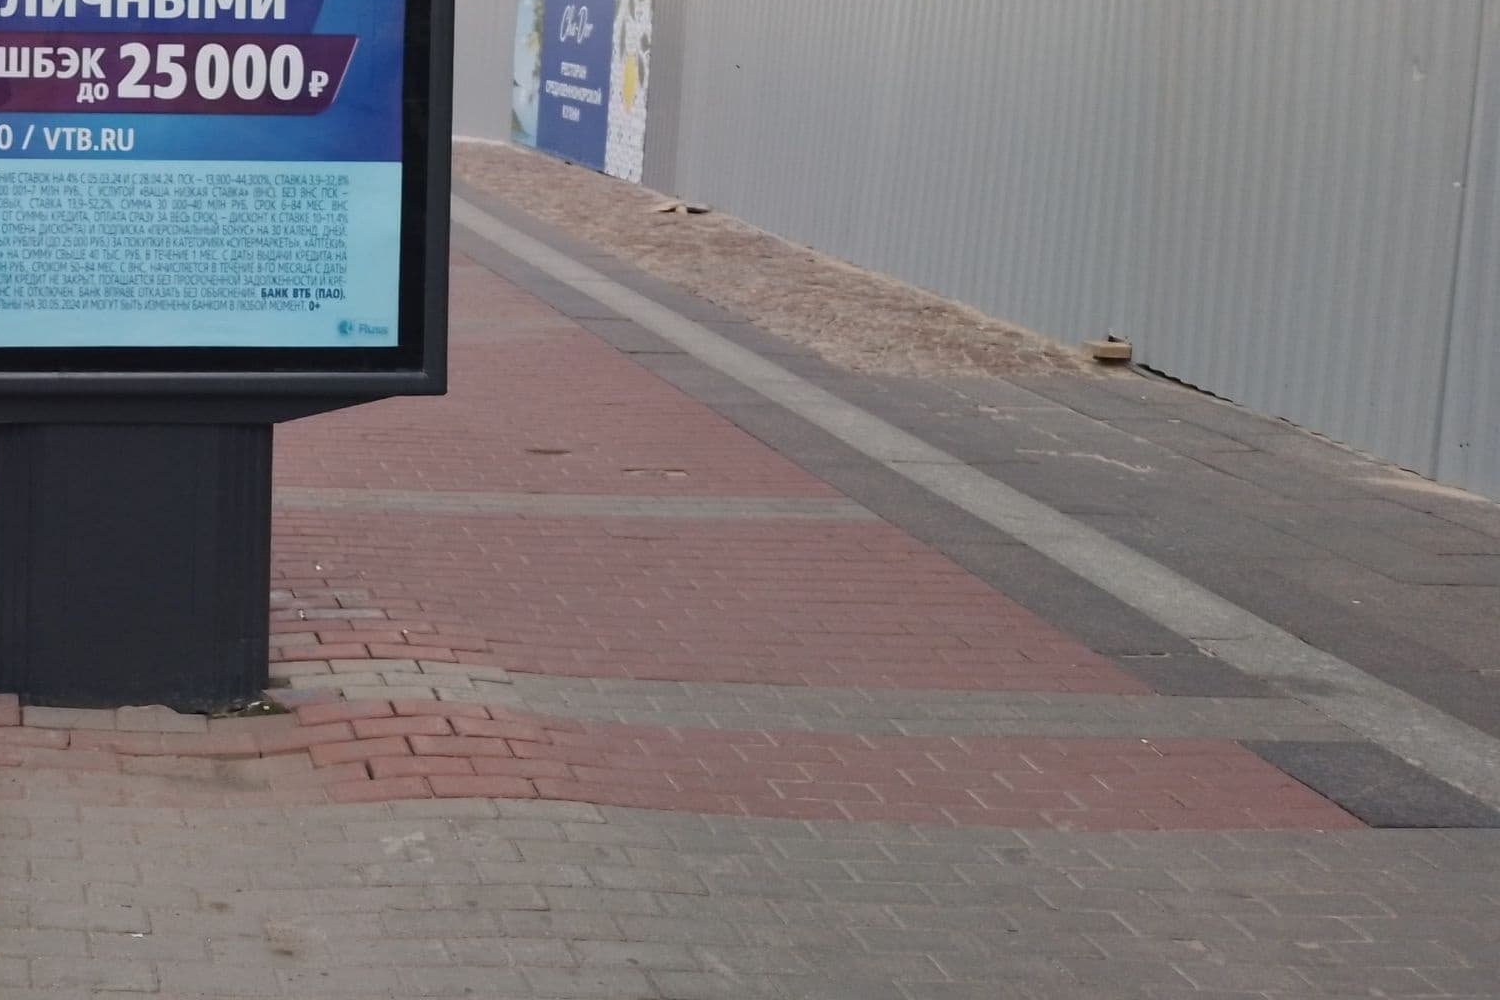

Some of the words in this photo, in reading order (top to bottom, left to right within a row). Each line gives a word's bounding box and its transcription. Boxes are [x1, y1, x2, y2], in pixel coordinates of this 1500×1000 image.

[43, 127, 134, 152] VTB.RU
[200, 288, 254, 298] ОБЪЯСНЕНИЯ.
[260, 288, 288, 298] БАНК
[292, 288, 310, 298] ВТБ
[314, 288, 345, 299] (ПАО).
